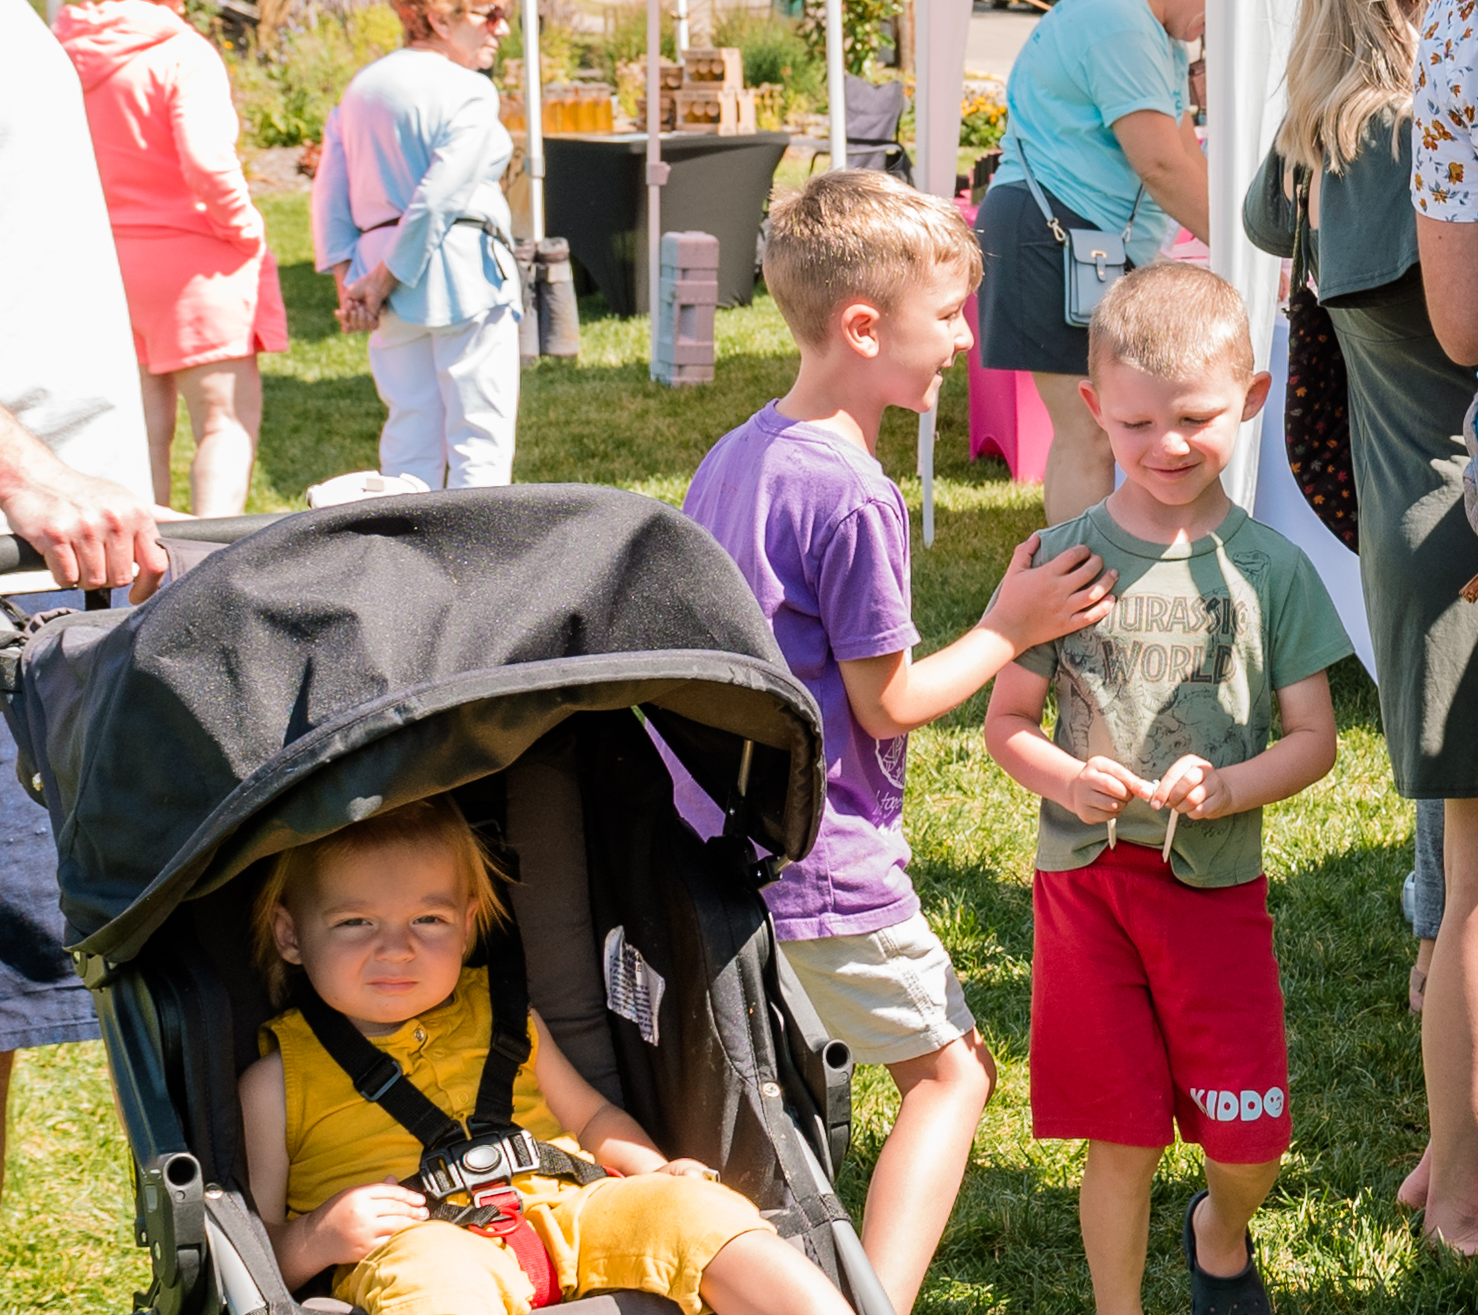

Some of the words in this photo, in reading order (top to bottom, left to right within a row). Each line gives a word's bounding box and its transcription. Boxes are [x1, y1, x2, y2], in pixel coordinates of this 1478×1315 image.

[1099, 586, 1247, 635] JURASSIC
[1101, 639, 1237, 685] WORLD
[1190, 1086, 1285, 1121] KIDDO
